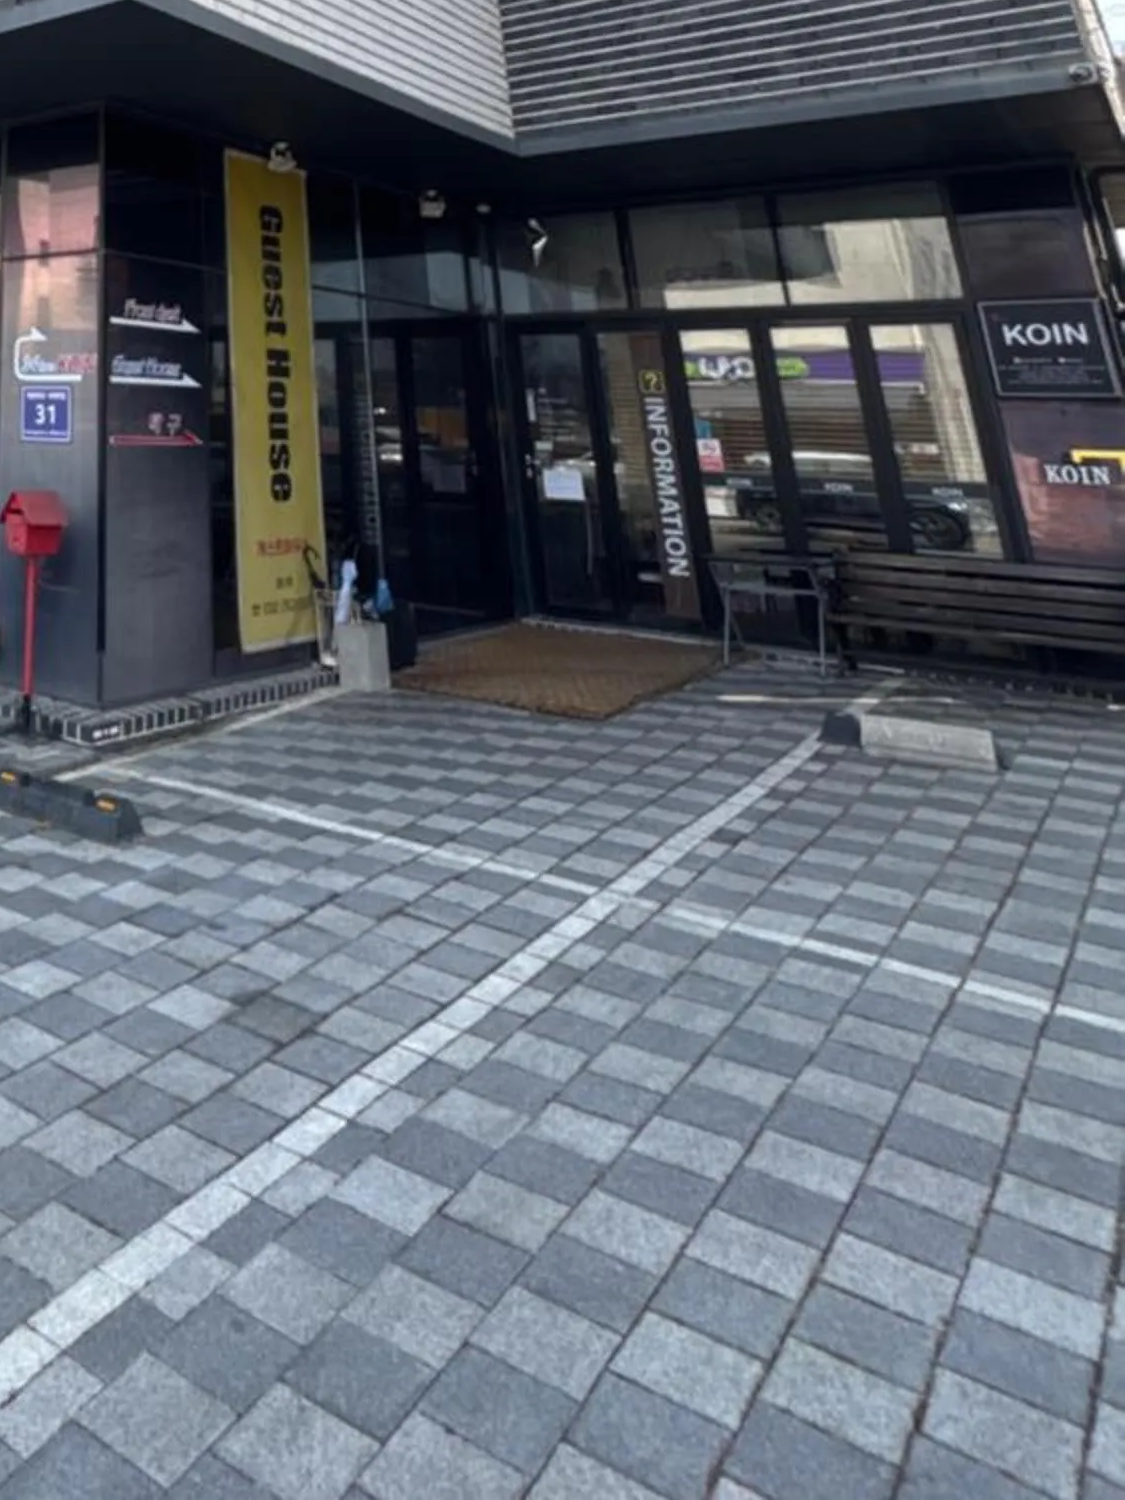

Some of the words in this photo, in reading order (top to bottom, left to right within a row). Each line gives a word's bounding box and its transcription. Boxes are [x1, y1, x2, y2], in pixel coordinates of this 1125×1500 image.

[1001, 322, 1090, 347] KOIN
[34, 403, 56, 426] 31
[1042, 463, 1112, 485] KOIN
[642, 396, 691, 578] INFORMATION
